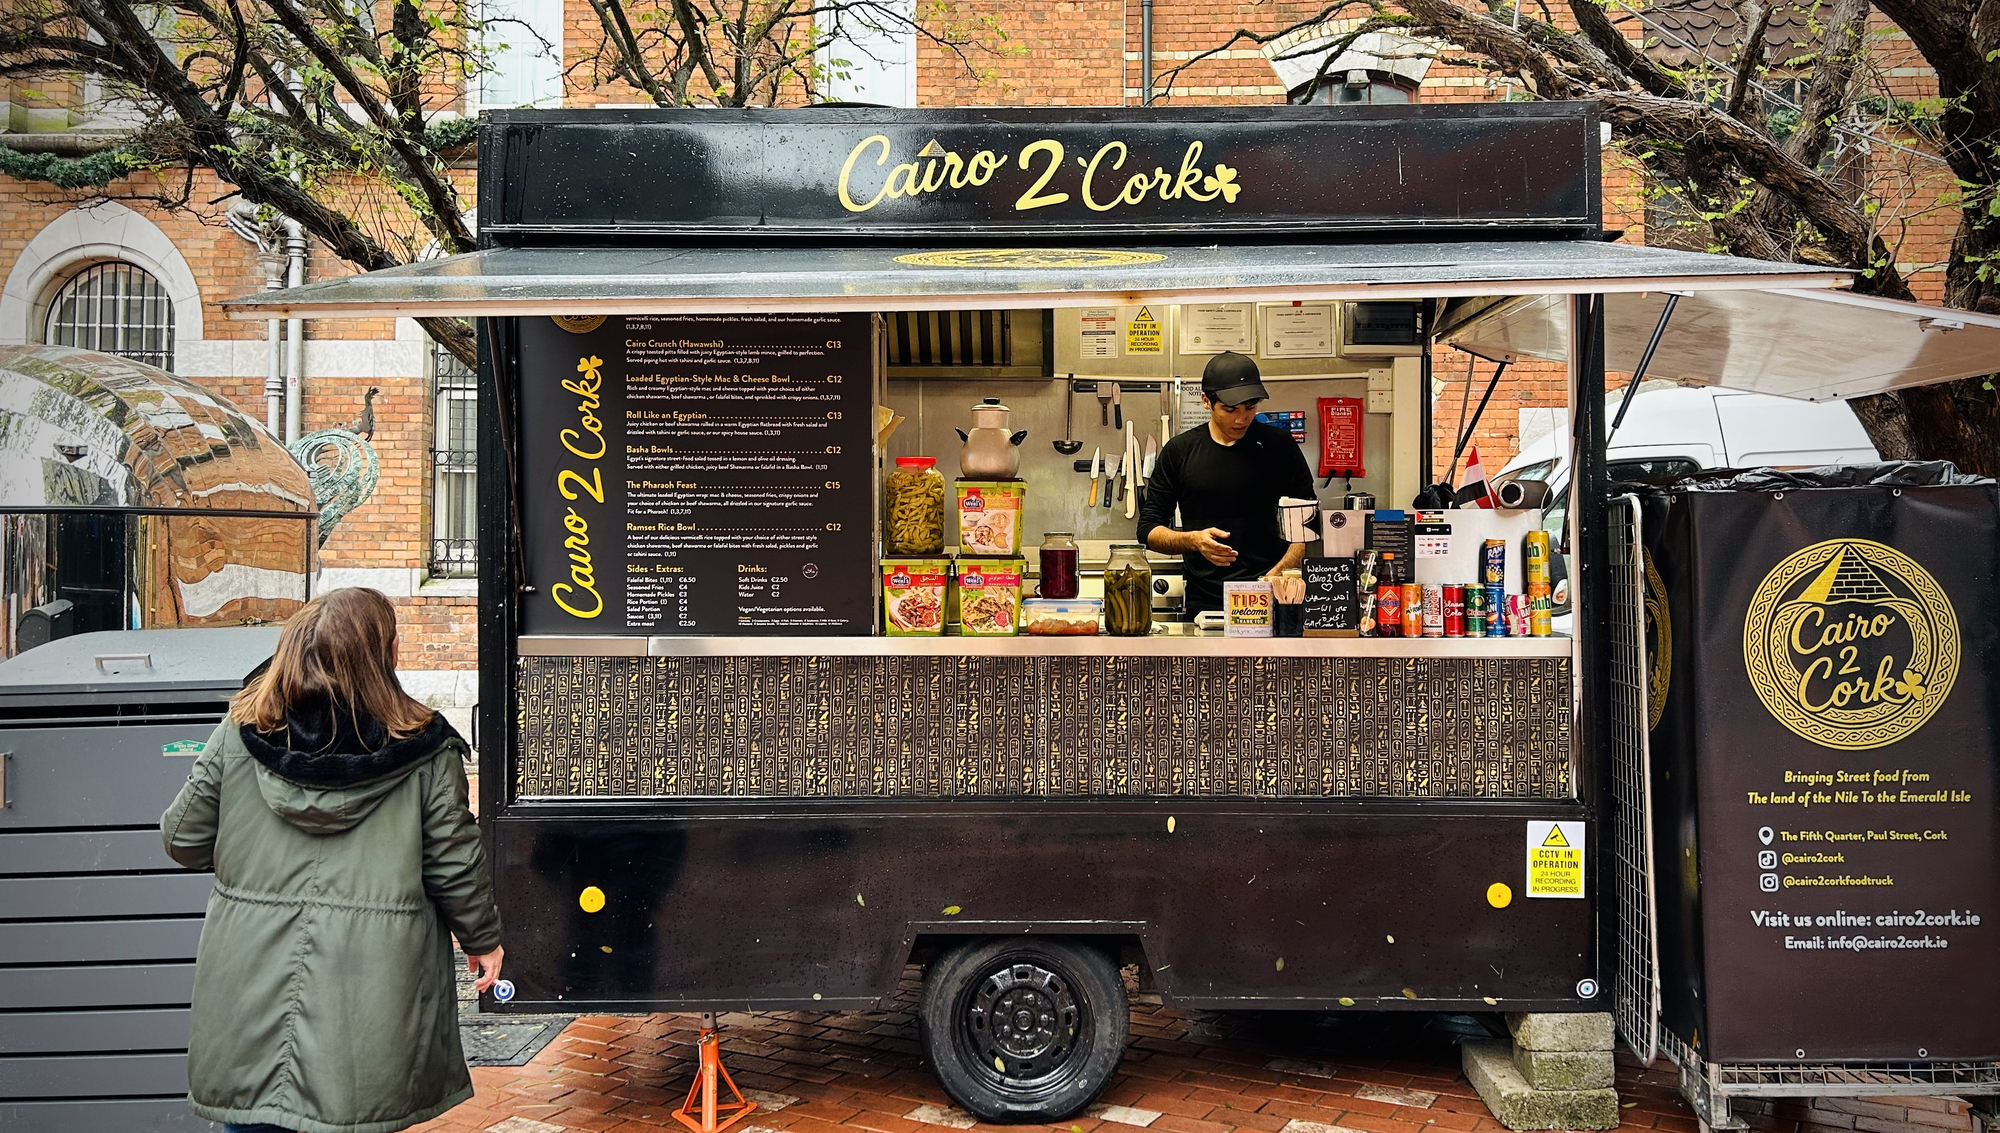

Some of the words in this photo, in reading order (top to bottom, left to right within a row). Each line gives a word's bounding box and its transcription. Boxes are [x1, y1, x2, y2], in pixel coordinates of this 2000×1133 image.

[838, 135, 1007, 212] Cairo
[1015, 139, 1069, 211] 2
[1081, 140, 1218, 211] Cork
[625, 339, 647, 348] Cairo
[648, 339, 677, 348] Crunch
[679, 340, 724, 349] (Hawawshi)
[826, 340, 842, 349] €13
[626, 374, 654, 382] Loaded
[655, 374, 712, 385] Egyptian-Style
[714, 375, 731, 383] Mac
[733, 375, 740, 383] &
[741, 375, 770, 383] Cheese
[771, 375, 790, 383] Bowl
[827, 375, 842, 383] €12
[559, 376, 607, 460] Cork
[626, 411, 641, 419] Roll
[643, 411, 660, 419] Like
[673, 411, 707, 421] Egyptian
[827, 412, 842, 420] €13
[626, 445, 649, 453] Basha
[651, 445, 673, 453] Bowls
[826, 446, 841, 454] €12
[558, 468, 604, 503] 2
[626, 481, 641, 489] The
[642, 481, 674, 489] Pharaoh
[677, 481, 697, 489] Feast
[825, 481, 841, 489] €15
[626, 523, 656, 531] Ramses
[658, 523, 675, 531] Rice
[677, 523, 696, 531] Bowl
[826, 523, 841, 531] €12
[551, 506, 603, 619] Cairo
[627, 564, 648, 573] Sides
[656, 564, 684, 573] Extras:
[738, 564, 768, 573] Drinks:
[1307, 564, 1338, 573] Welcome
[1340, 564, 1349, 572] to
[1308, 574, 1326, 583] Cairo
[1326, 574, 1333, 582] 2
[1333, 572, 1350, 582] Cork
[1232, 594, 1268, 607] TIPS
[1531, 594, 1551, 610] club
[1231, 607, 1267, 615] welcome
[1444, 608, 1462, 617] Cola
[1791, 606, 1895, 655] Cairo
[1839, 646, 1860, 675] 2
[1799, 655, 1898, 712] Cork
[1784, 771, 1833, 786] Bringing
[1836, 771, 1870, 783] Street
[1873, 769, 1899, 786] food
[1902, 770, 1930, 785] from
[1748, 792, 1767, 804] The
[1770, 791, 1794, 804] land
[1798, 791, 1811, 807] of
[1813, 791, 1831, 803] the
[1835, 791, 1858, 803] Nile
[1861, 791, 1874, 803] To
[1877, 791, 1896, 803] the
[1900, 790, 1947, 803] Emerald
[1951, 790, 1971, 802] Isle
[1780, 831, 1798, 841] The
[1800, 831, 1823, 841] Fifth
[1825, 831, 1865, 842] Quarter,
[1867, 831, 1887, 841] Paul
[1890, 831, 1922, 842] Street,
[1924, 830, 1947, 840] Cork
[1539, 850, 1560, 858] CCTV
[1564, 850, 1573, 858] IN
[1781, 853, 1845, 865] @cairo2cork
[1533, 860, 1579, 869] OPERATION
[1782, 875, 1894, 888] @cairo2corkfoodtruck
[1750, 910, 1790, 927] Visit
[1794, 915, 1812, 927] us
[1816, 910, 1872, 927] online:
[1875, 910, 1981, 926] cairo2cork.ie
[1785, 936, 1824, 949] Email:
[1827, 935, 1948, 952] info@cairo2cork.ie
